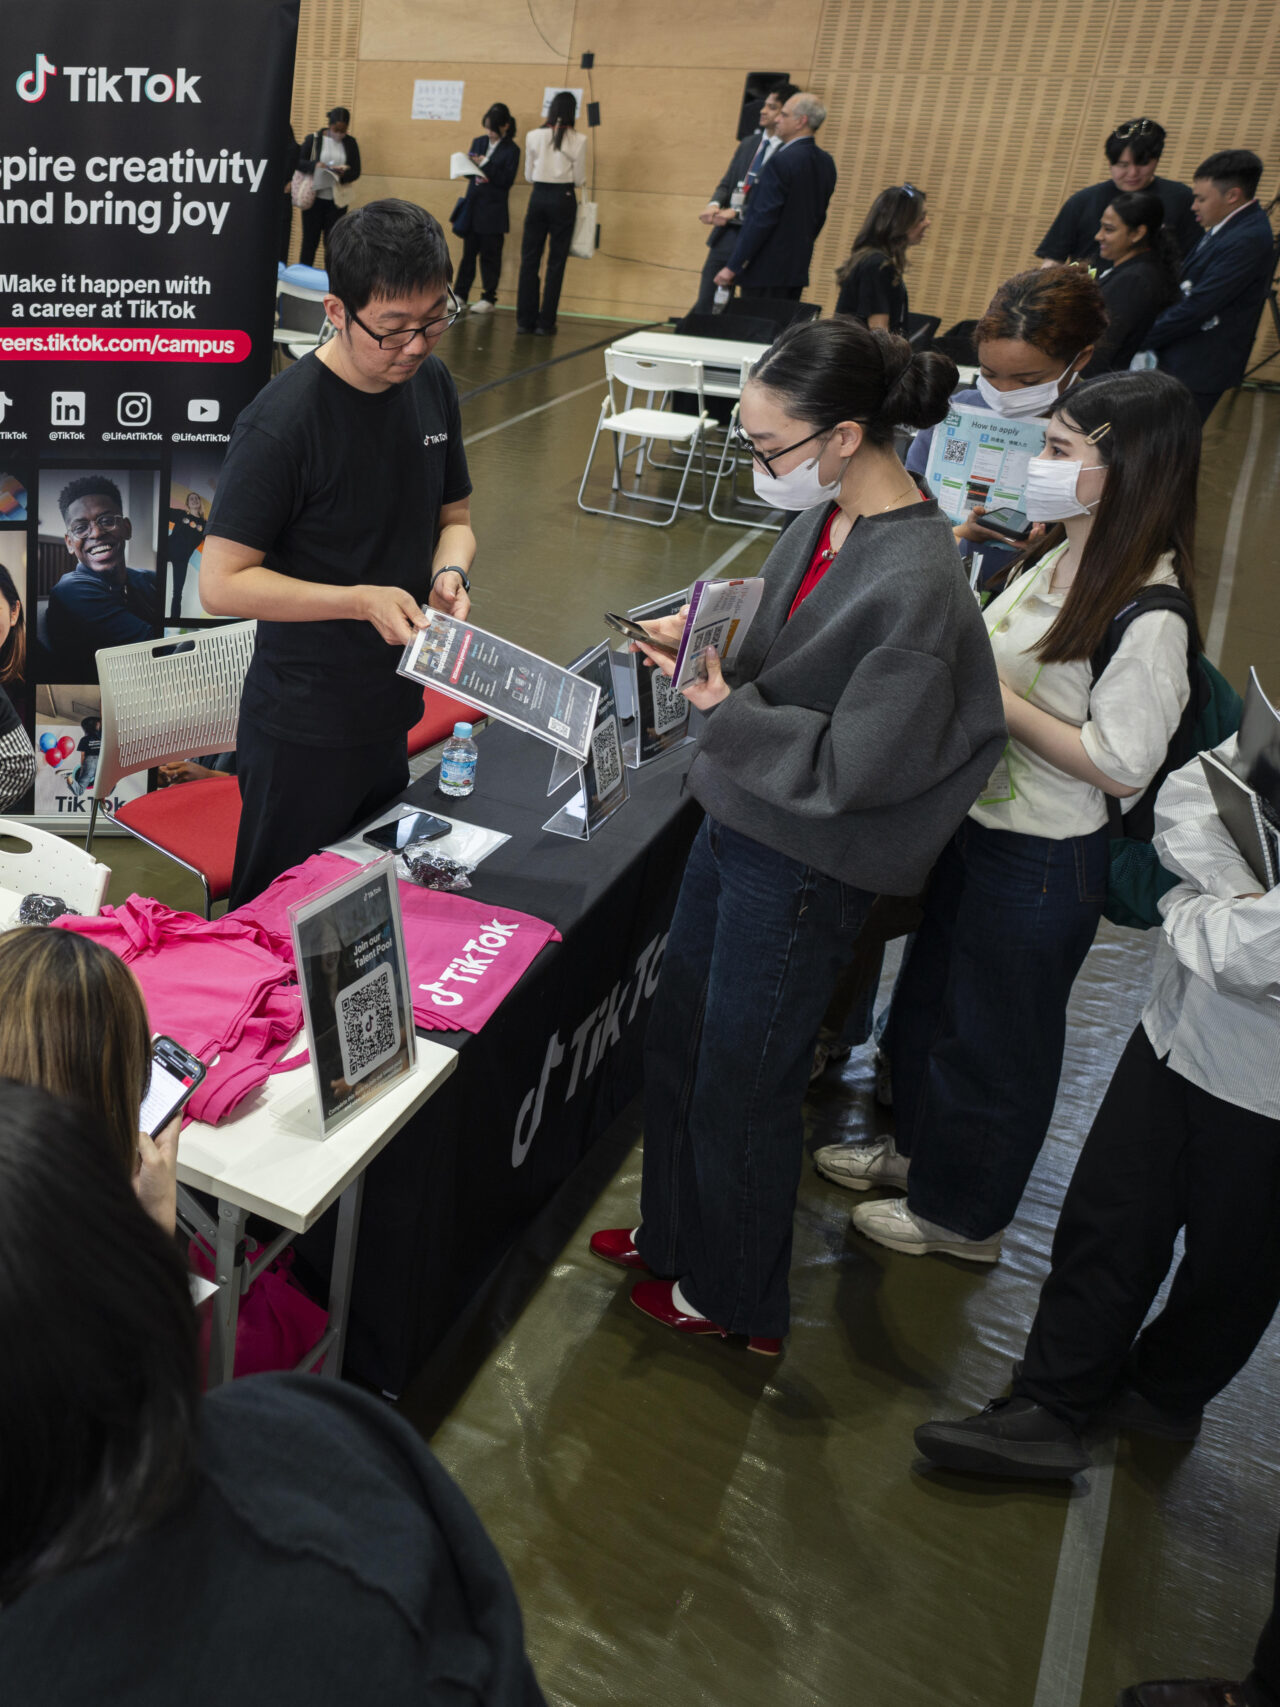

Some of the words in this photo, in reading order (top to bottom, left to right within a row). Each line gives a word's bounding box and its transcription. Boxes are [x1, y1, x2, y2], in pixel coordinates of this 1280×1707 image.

[63, 67, 202, 103] TikTok
[85, 149, 268, 193] creativity
[64, 191, 162, 234] bring
[168, 192, 231, 235] joy
[60, 274, 76, 293] it
[81, 275, 161, 299] happen
[165, 275, 212, 295] with
[11, 303, 25, 318] a
[29, 302, 97, 318] career
[101, 302, 122, 319] at
[127, 300, 197, 320] TikTok
[49, 431, 85, 441] @TikTok
[101, 431, 163, 442] @LifeAtTikTok
[430, 432, 448, 444] TikTok
[971, 420, 988, 431] How
[990, 423, 998, 432] to
[998, 425, 1020, 437] apply
[353, 941, 369, 957] Join
[369, 933, 381, 946] our
[354, 948, 377, 968] Talent
[376, 938, 393, 955] Pool
[440, 918, 520, 984] TikTok
[565, 931, 670, 1104] TikTo
